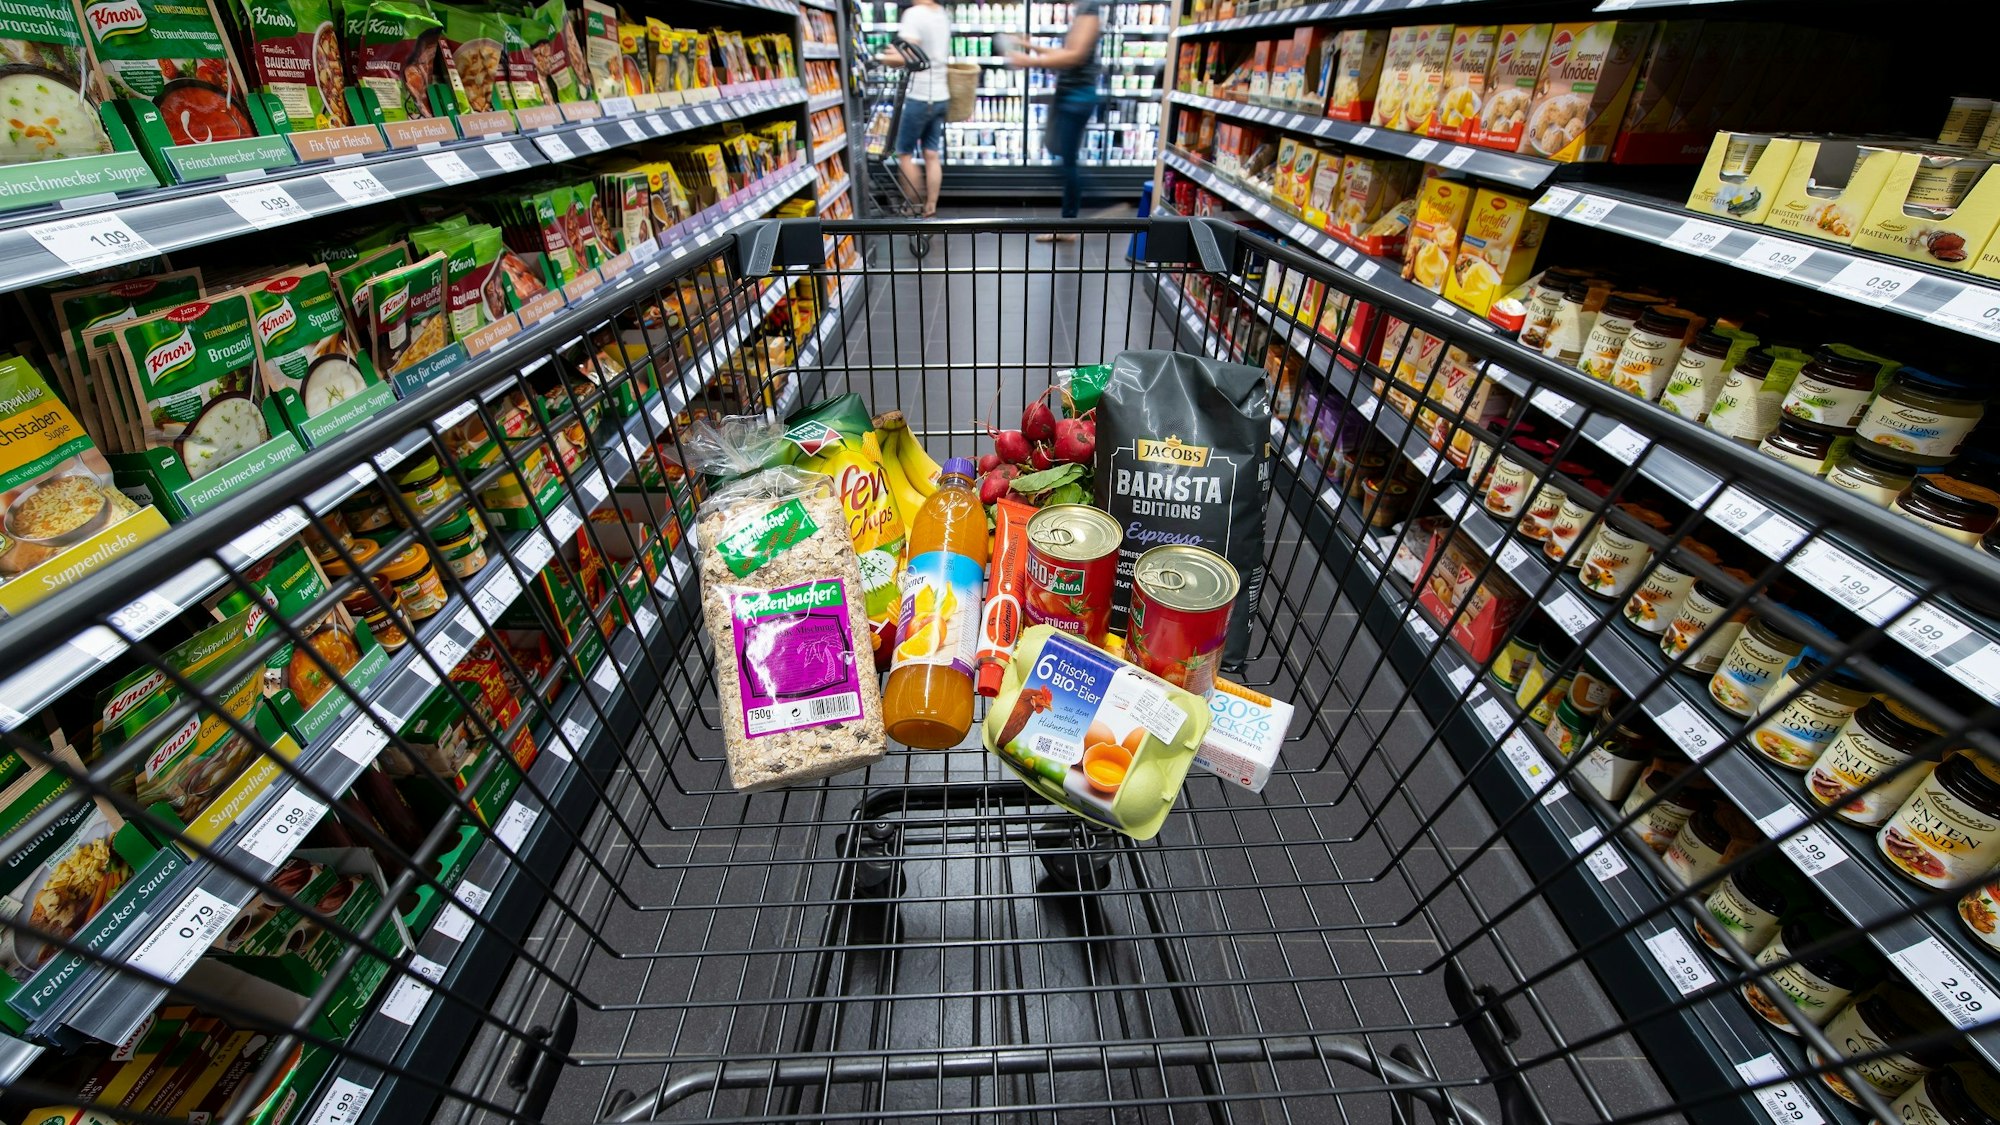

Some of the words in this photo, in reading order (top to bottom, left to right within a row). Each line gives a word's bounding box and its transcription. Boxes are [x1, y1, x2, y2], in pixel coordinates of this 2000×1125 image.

[89, 7, 142, 29] Knorr
[252, 6, 296, 28] Knorr
[368, 18, 405, 36] Knorr
[150, 28, 218, 40] Strauchtomaten
[264, 56, 312, 71] BAUERNTOPF
[1460, 58, 1484, 73] Knödel
[1520, 49, 1542, 60] Semmel
[1575, 51, 1604, 62] Semmel
[1507, 61, 1537, 77] Knödel
[1560, 62, 1600, 80] Knödel
[309, 138, 324, 152] Fix
[326, 135, 341, 155] für
[343, 131, 372, 148] Fleisch
[398, 128, 411, 141] Fix
[412, 125, 427, 142] für
[428, 123, 447, 138] Fleisch
[178, 148, 255, 172] Feinschmecker
[258, 146, 287, 161] Suppe
[104, 165, 147, 184] Suppe
[353, 178, 377, 191] 0.79
[261, 196, 290, 211] 0.99
[1426, 195, 1456, 215] Kartoffel
[1477, 207, 1512, 230] Kartoffel
[1780, 217, 1800, 228] PASTE
[90, 229, 130, 248] 1.09
[1481, 226, 1502, 242] Püree
[1692, 233, 1716, 244] 0.99
[1859, 228, 1921, 247] BRATEN-PASTE
[450, 257, 476, 274] Knorr
[1769, 252, 1797, 266] 0.99
[1866, 276, 1900, 292] 0.99
[382, 290, 409, 316] Knorr
[453, 288, 480, 306] ROULADEN
[259, 308, 293, 337] Knorr
[474, 336, 484, 348] Fix
[484, 331, 494, 346] für
[495, 321, 513, 340] Fleisch
[1628, 332, 1667, 350] Lacroix
[147, 339, 192, 373] Knorr
[207, 333, 251, 364] Broccoli
[406, 372, 418, 387] Fix
[418, 366, 430, 384] für
[431, 352, 457, 372] Gemüse
[1620, 359, 1646, 372] FOND
[311, 402, 367, 441] Feinschmecker
[368, 389, 391, 412] Suppe
[1880, 415, 1907, 431] FISCH
[1909, 424, 1939, 438] FOND
[1891, 409, 1939, 425] Lacroix
[44, 423, 71, 442] Suppe
[6, 474, 19, 485] mit
[21, 463, 43, 479] vielen
[71, 440, 85, 452] A-Z
[1142, 444, 1202, 463] JACOBS
[190, 458, 267, 507] Feinschmecker
[267, 440, 297, 470] Suppe
[841, 464, 889, 511] fen
[1116, 469, 1222, 504] BARISTA
[1132, 501, 1202, 520] EDITIONS
[1723, 502, 1748, 521] 1.99
[850, 506, 894, 541] Chips
[1126, 521, 1203, 547] Espresso
[41, 530, 138, 592] Suppenliebe
[1503, 551, 1517, 563] 2.99
[1839, 573, 1870, 595] 1.99
[481, 597, 496, 612] 1.79
[1931, 610, 1944, 621] FOND
[1044, 616, 1080, 631] STÜCKIG
[1568, 614, 1586, 630] 2.99
[1908, 616, 1944, 641] 1.99
[439, 640, 457, 658] 1.79
[1738, 636, 1784, 665] Lacroix
[361, 653, 385, 679] Suppe
[1036, 654, 1058, 680] 6
[1057, 659, 1096, 686] frische
[1727, 661, 1757, 684] FOND
[1730, 647, 1771, 680] FISCH
[105, 671, 164, 720] Knorr
[1051, 672, 1101, 705] BIO-Eier
[749, 708, 772, 721] 750g
[1210, 694, 1273, 732] 30%
[1782, 703, 1840, 734] FISCH
[1683, 727, 1708, 748] 2.99
[1782, 718, 1824, 740] FOND
[147, 718, 199, 772] Knorr
[1516, 745, 1531, 761] 0.59
[209, 760, 279, 828] Suppenliebe
[493, 778, 511, 805] Soße
[70, 801, 91, 825] Sauce
[275, 807, 304, 835] 0.89
[1925, 787, 1997, 832] Lacroix
[1909, 816, 1955, 850] FOND
[1911, 797, 1983, 850] ENTEN
[1795, 834, 1826, 861] 2.99
[1594, 850, 1613, 870] 2.99
[31, 897, 137, 1007] Feinscmecker
[138, 859, 177, 899] Sauce
[143, 920, 174, 954] CHAMPIGNON
[172, 906, 186, 922] RAHM
[184, 893, 200, 908] SAUCE
[179, 905, 214, 939] 0.79
[1675, 957, 1699, 983] 2.99
[1763, 949, 1826, 1008] WLDPILZ
[1930, 940, 1941, 950] LAC
[1941, 949, 1972, 978] KALBS-FOND
[1970, 975, 1988, 995] 400ML
[1941, 977, 1983, 1012] 2.99
[1769, 1056, 1777, 1066] LAC
[329, 1093, 354, 1123] 1.99
[1774, 1088, 1804, 1121] 2.99
